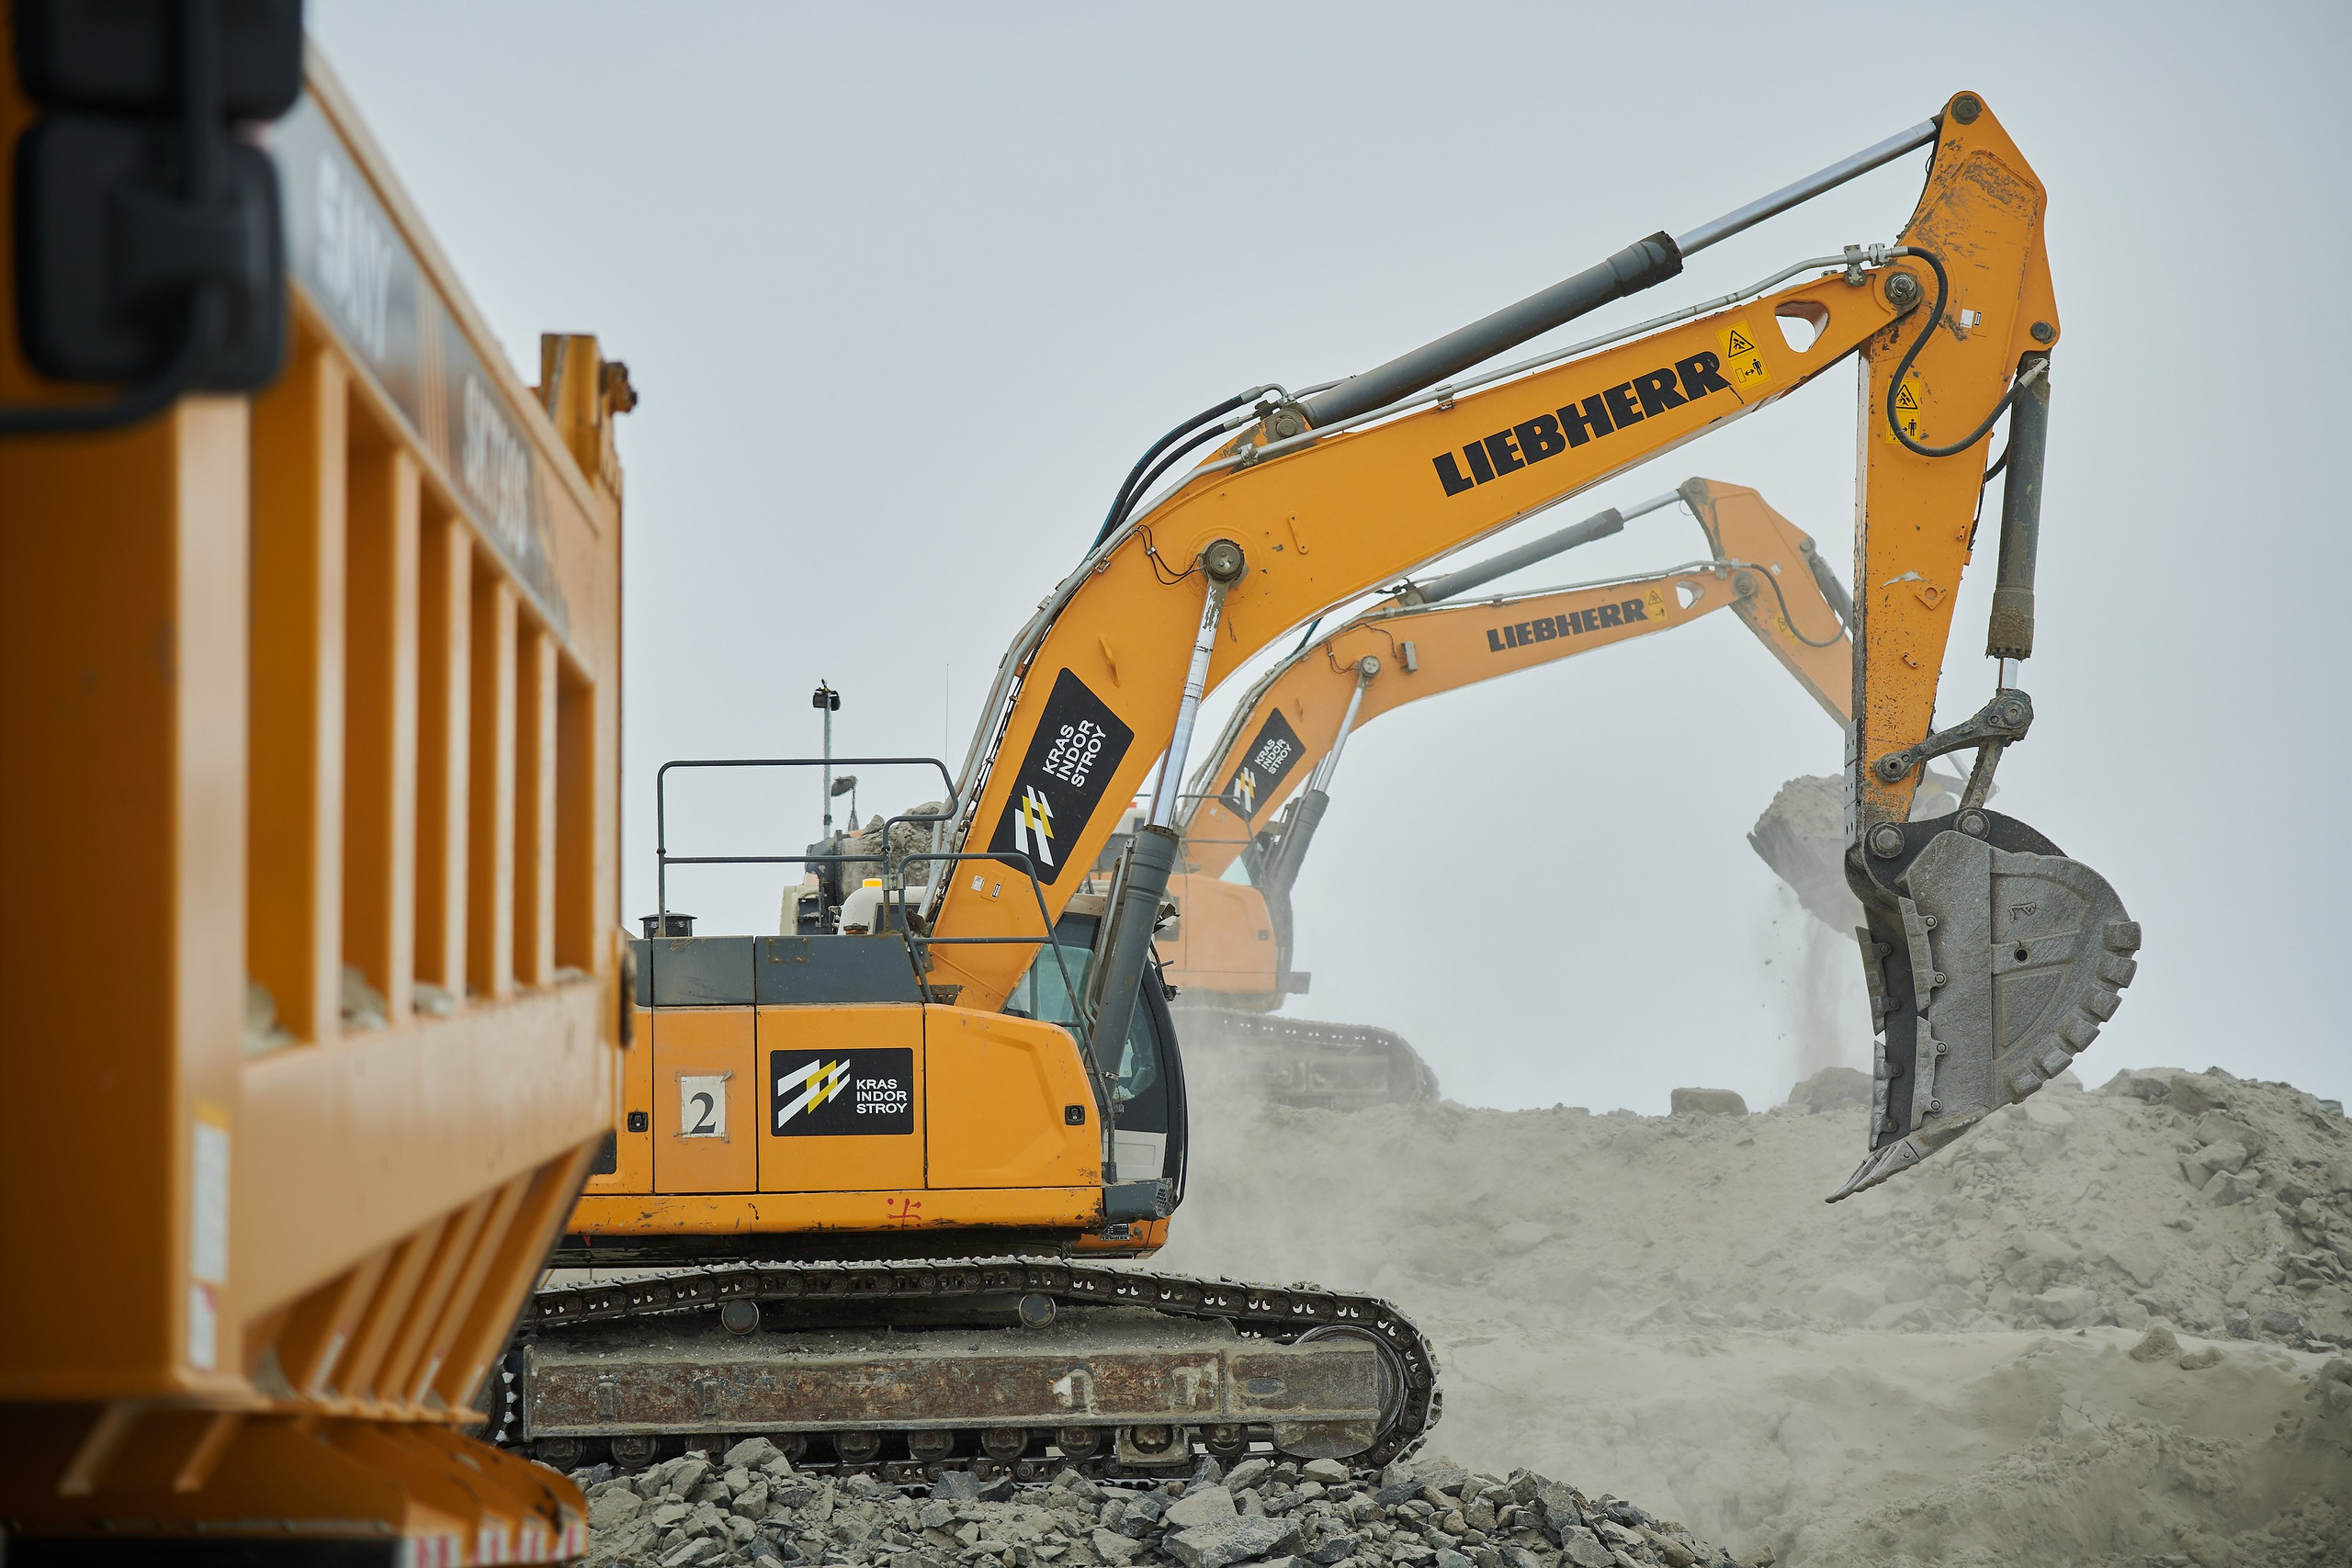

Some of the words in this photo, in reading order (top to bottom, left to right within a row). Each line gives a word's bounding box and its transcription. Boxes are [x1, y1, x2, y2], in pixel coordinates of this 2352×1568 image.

[1431, 350, 1733, 498] LIEBHERR
[1486, 597, 1648, 653] LIEBHERR
[1042, 724, 1075, 775] KRAS
[1056, 719, 1095, 782] INDOR
[1070, 724, 1107, 788] STROY
[1254, 739, 1275, 765] KRAS
[1261, 739, 1287, 770] INDOR
[1268, 743, 1292, 774] STROY
[855, 1078, 899, 1090] KRAS
[855, 1090, 908, 1102] INDOR
[689, 1091, 717, 1134] 2
[855, 1102, 909, 1114] STROY
